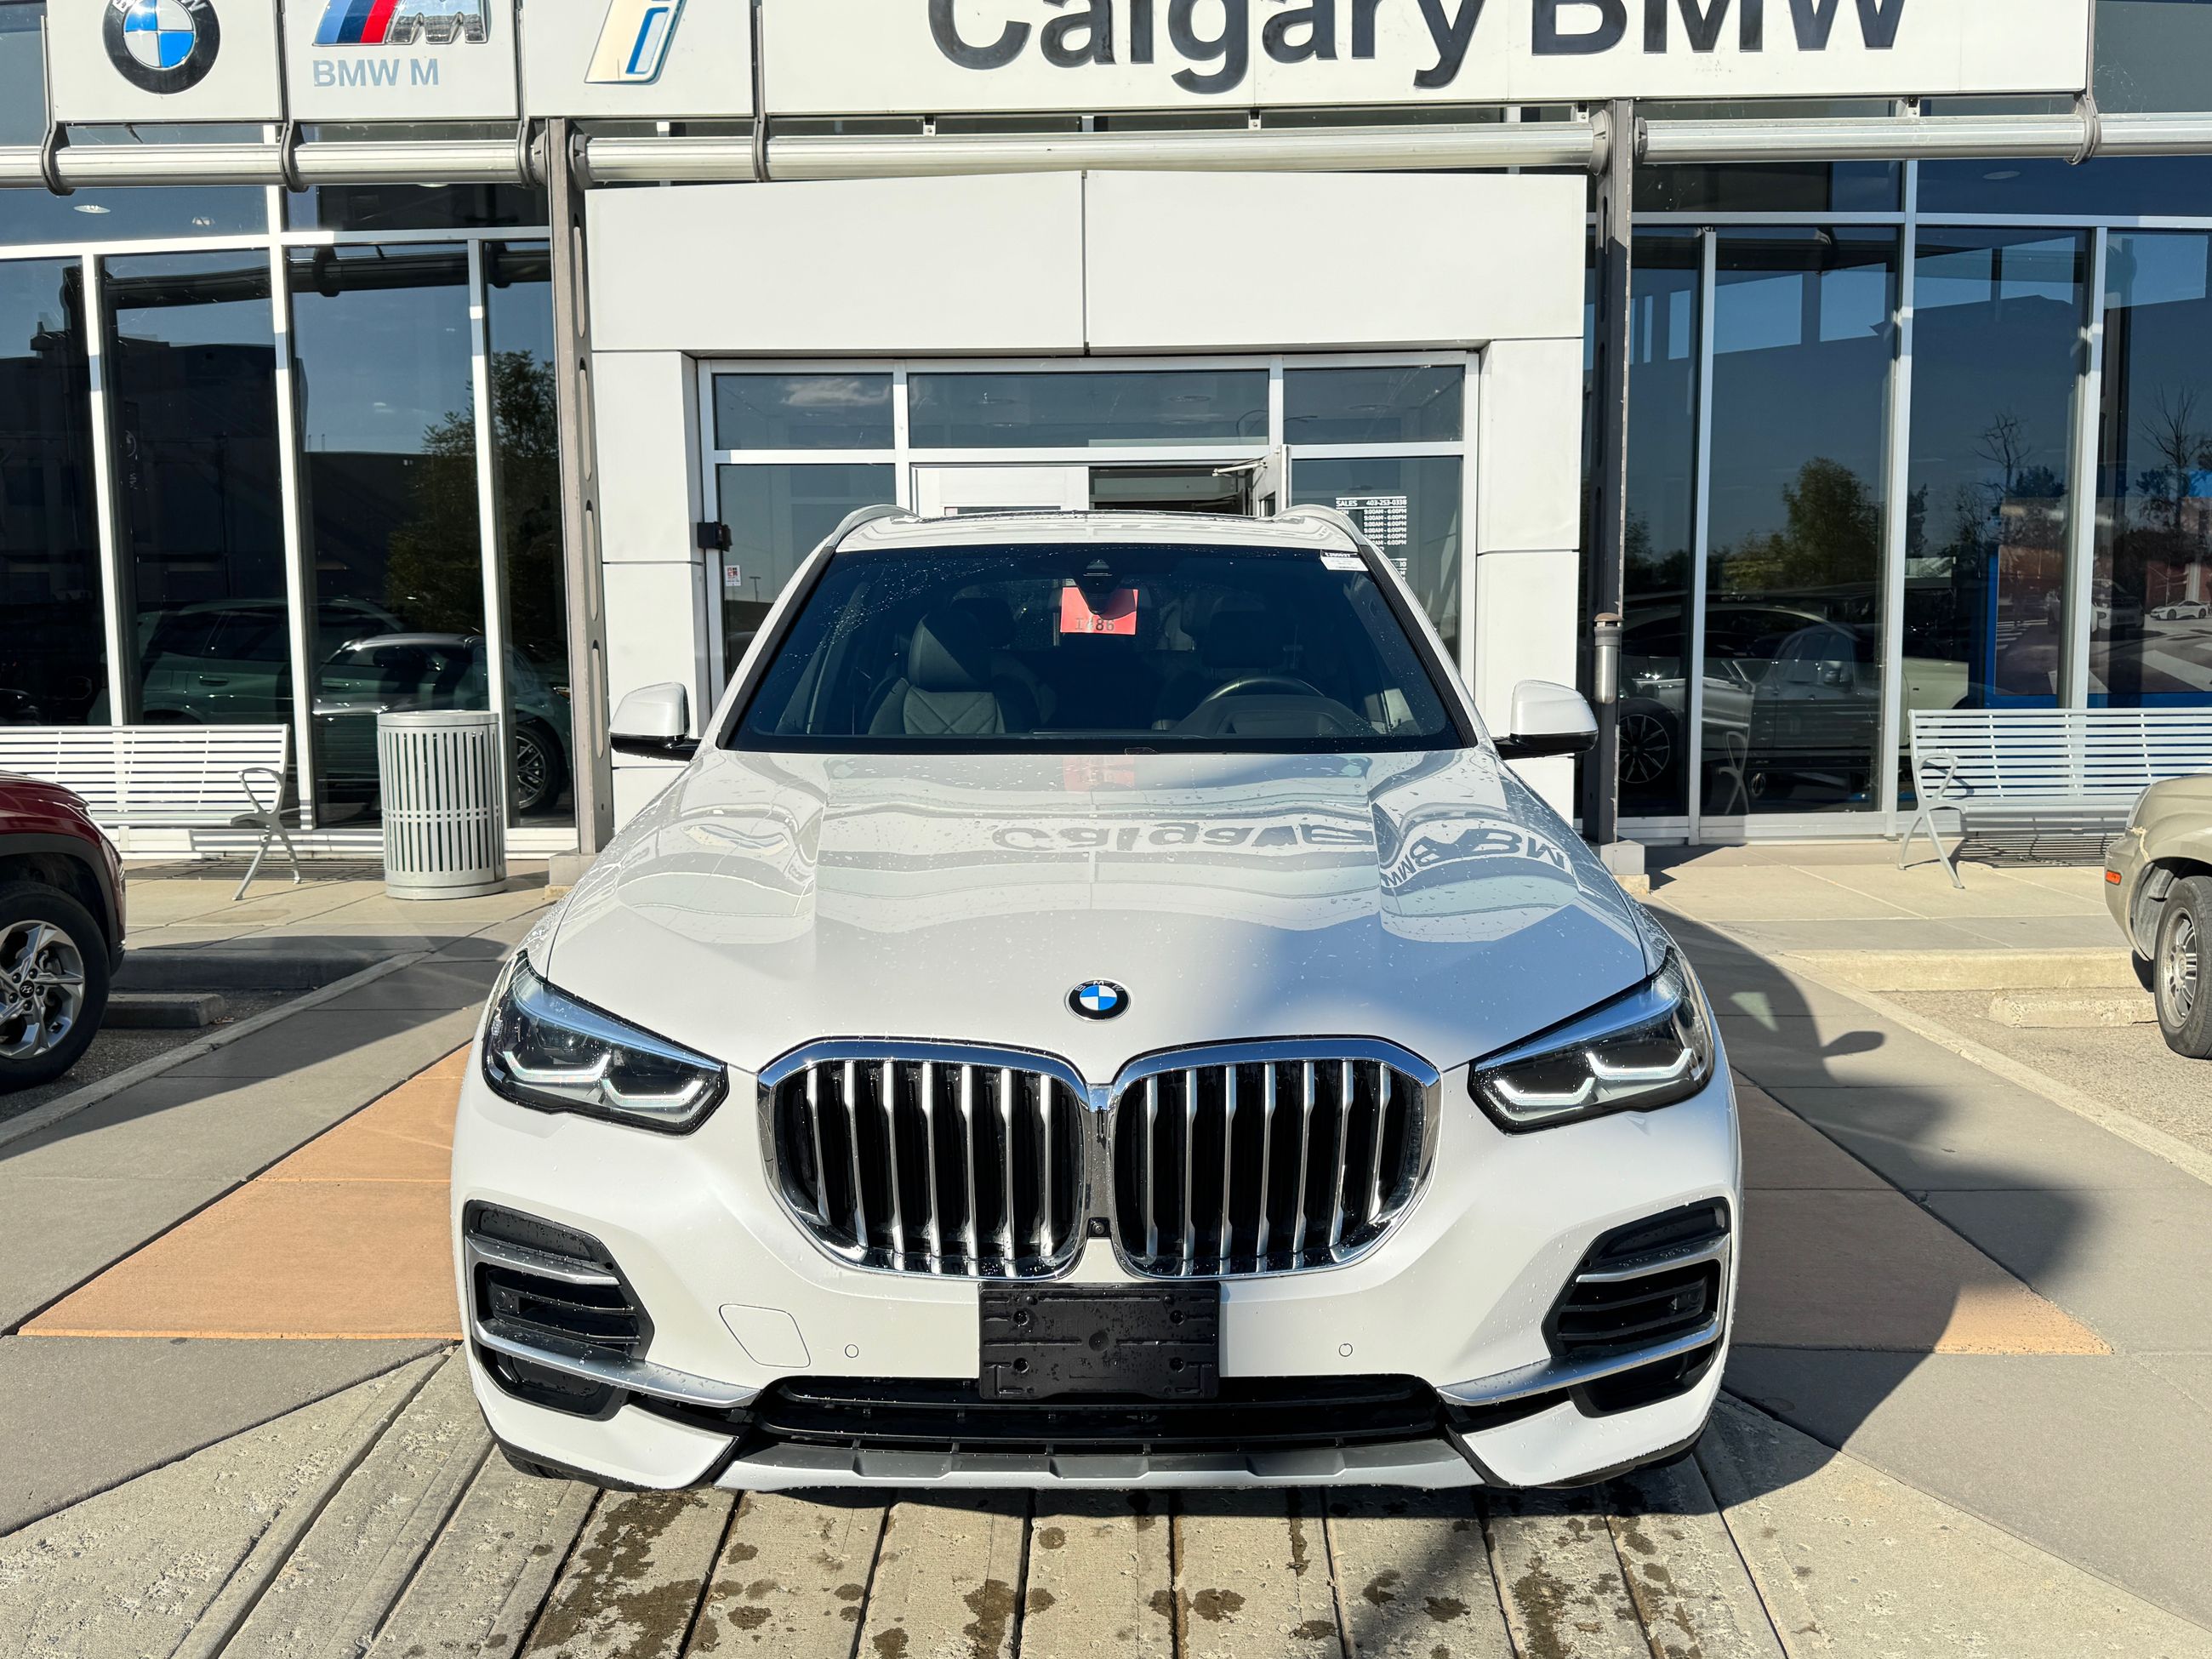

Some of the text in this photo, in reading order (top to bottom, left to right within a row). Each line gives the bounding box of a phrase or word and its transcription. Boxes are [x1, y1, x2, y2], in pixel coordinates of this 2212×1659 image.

[929, 0, 1482, 94] Calgary
[312, 58, 439, 88] BMW M
[1075, 980, 1124, 992] BMW
